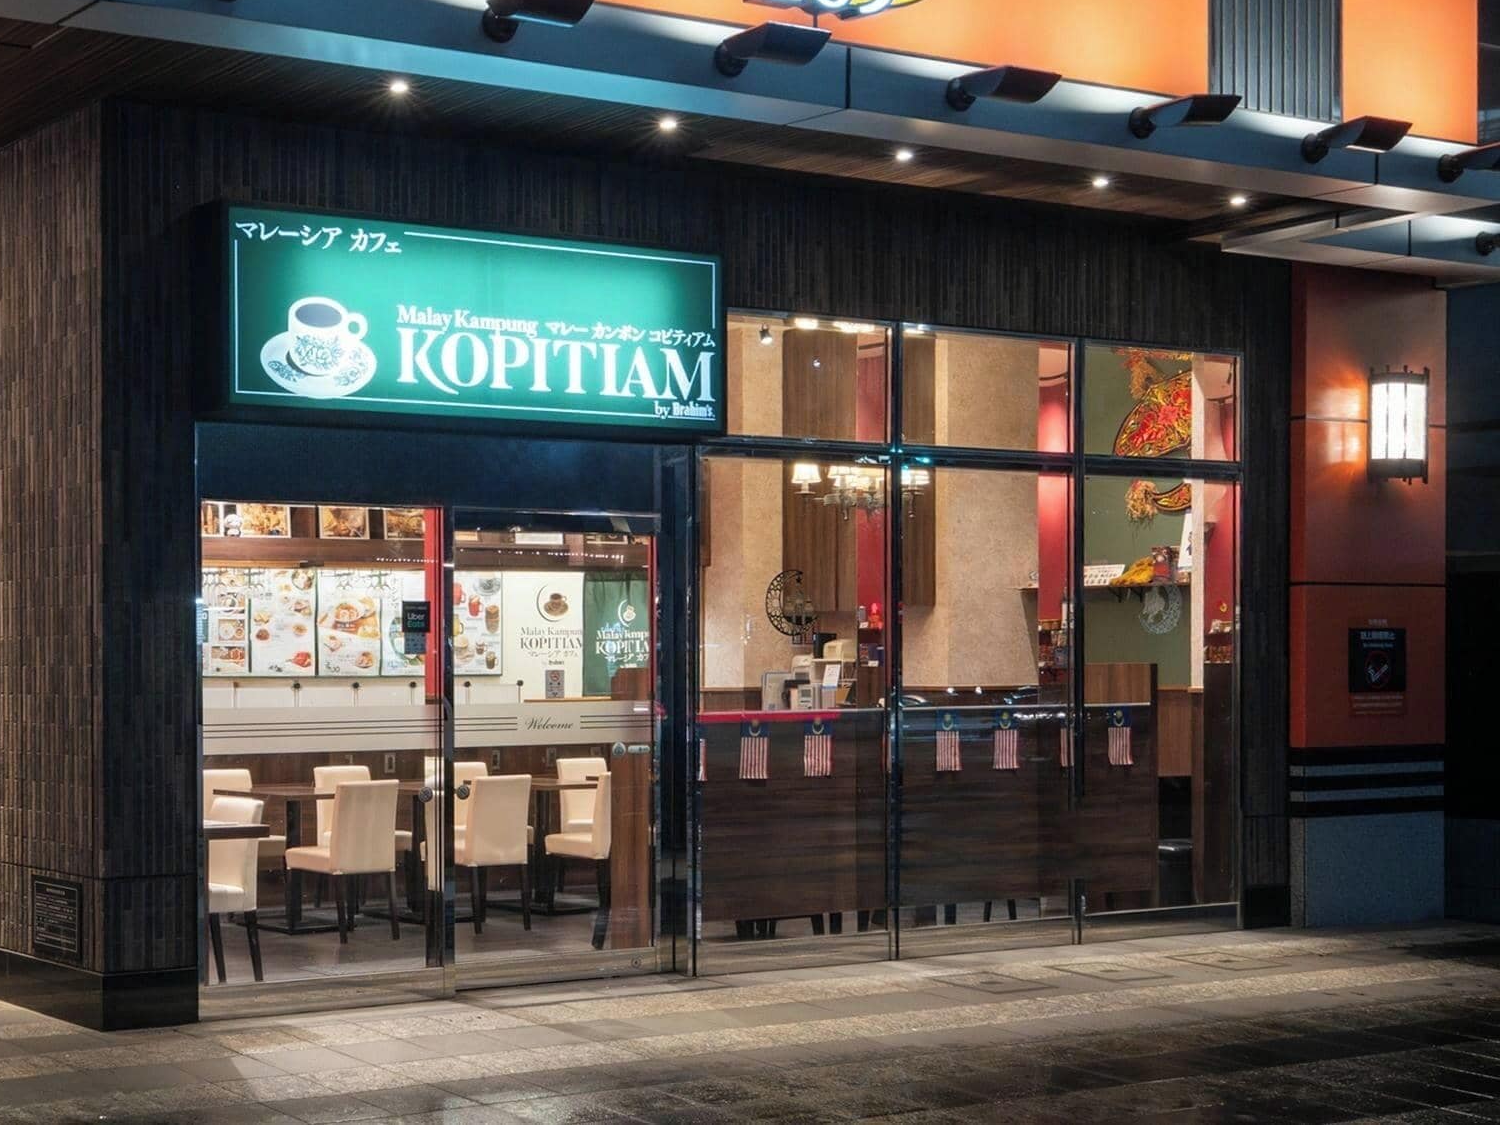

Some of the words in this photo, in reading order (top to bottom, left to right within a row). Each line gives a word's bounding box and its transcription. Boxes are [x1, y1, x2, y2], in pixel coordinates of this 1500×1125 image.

[234, 221, 343, 250] マレーシア
[348, 227, 403, 254] カフェ
[396, 304, 453, 331] Malay
[453, 309, 540, 338] Kampung
[544, 320, 589, 336] マレー
[396, 326, 717, 402] KOPITIAM
[653, 400, 670, 420] by
[406, 612, 425, 620] Uber
[406, 620, 425, 628] Eats
[520, 626, 546, 637] Malay
[524, 716, 575, 732] Welcome
